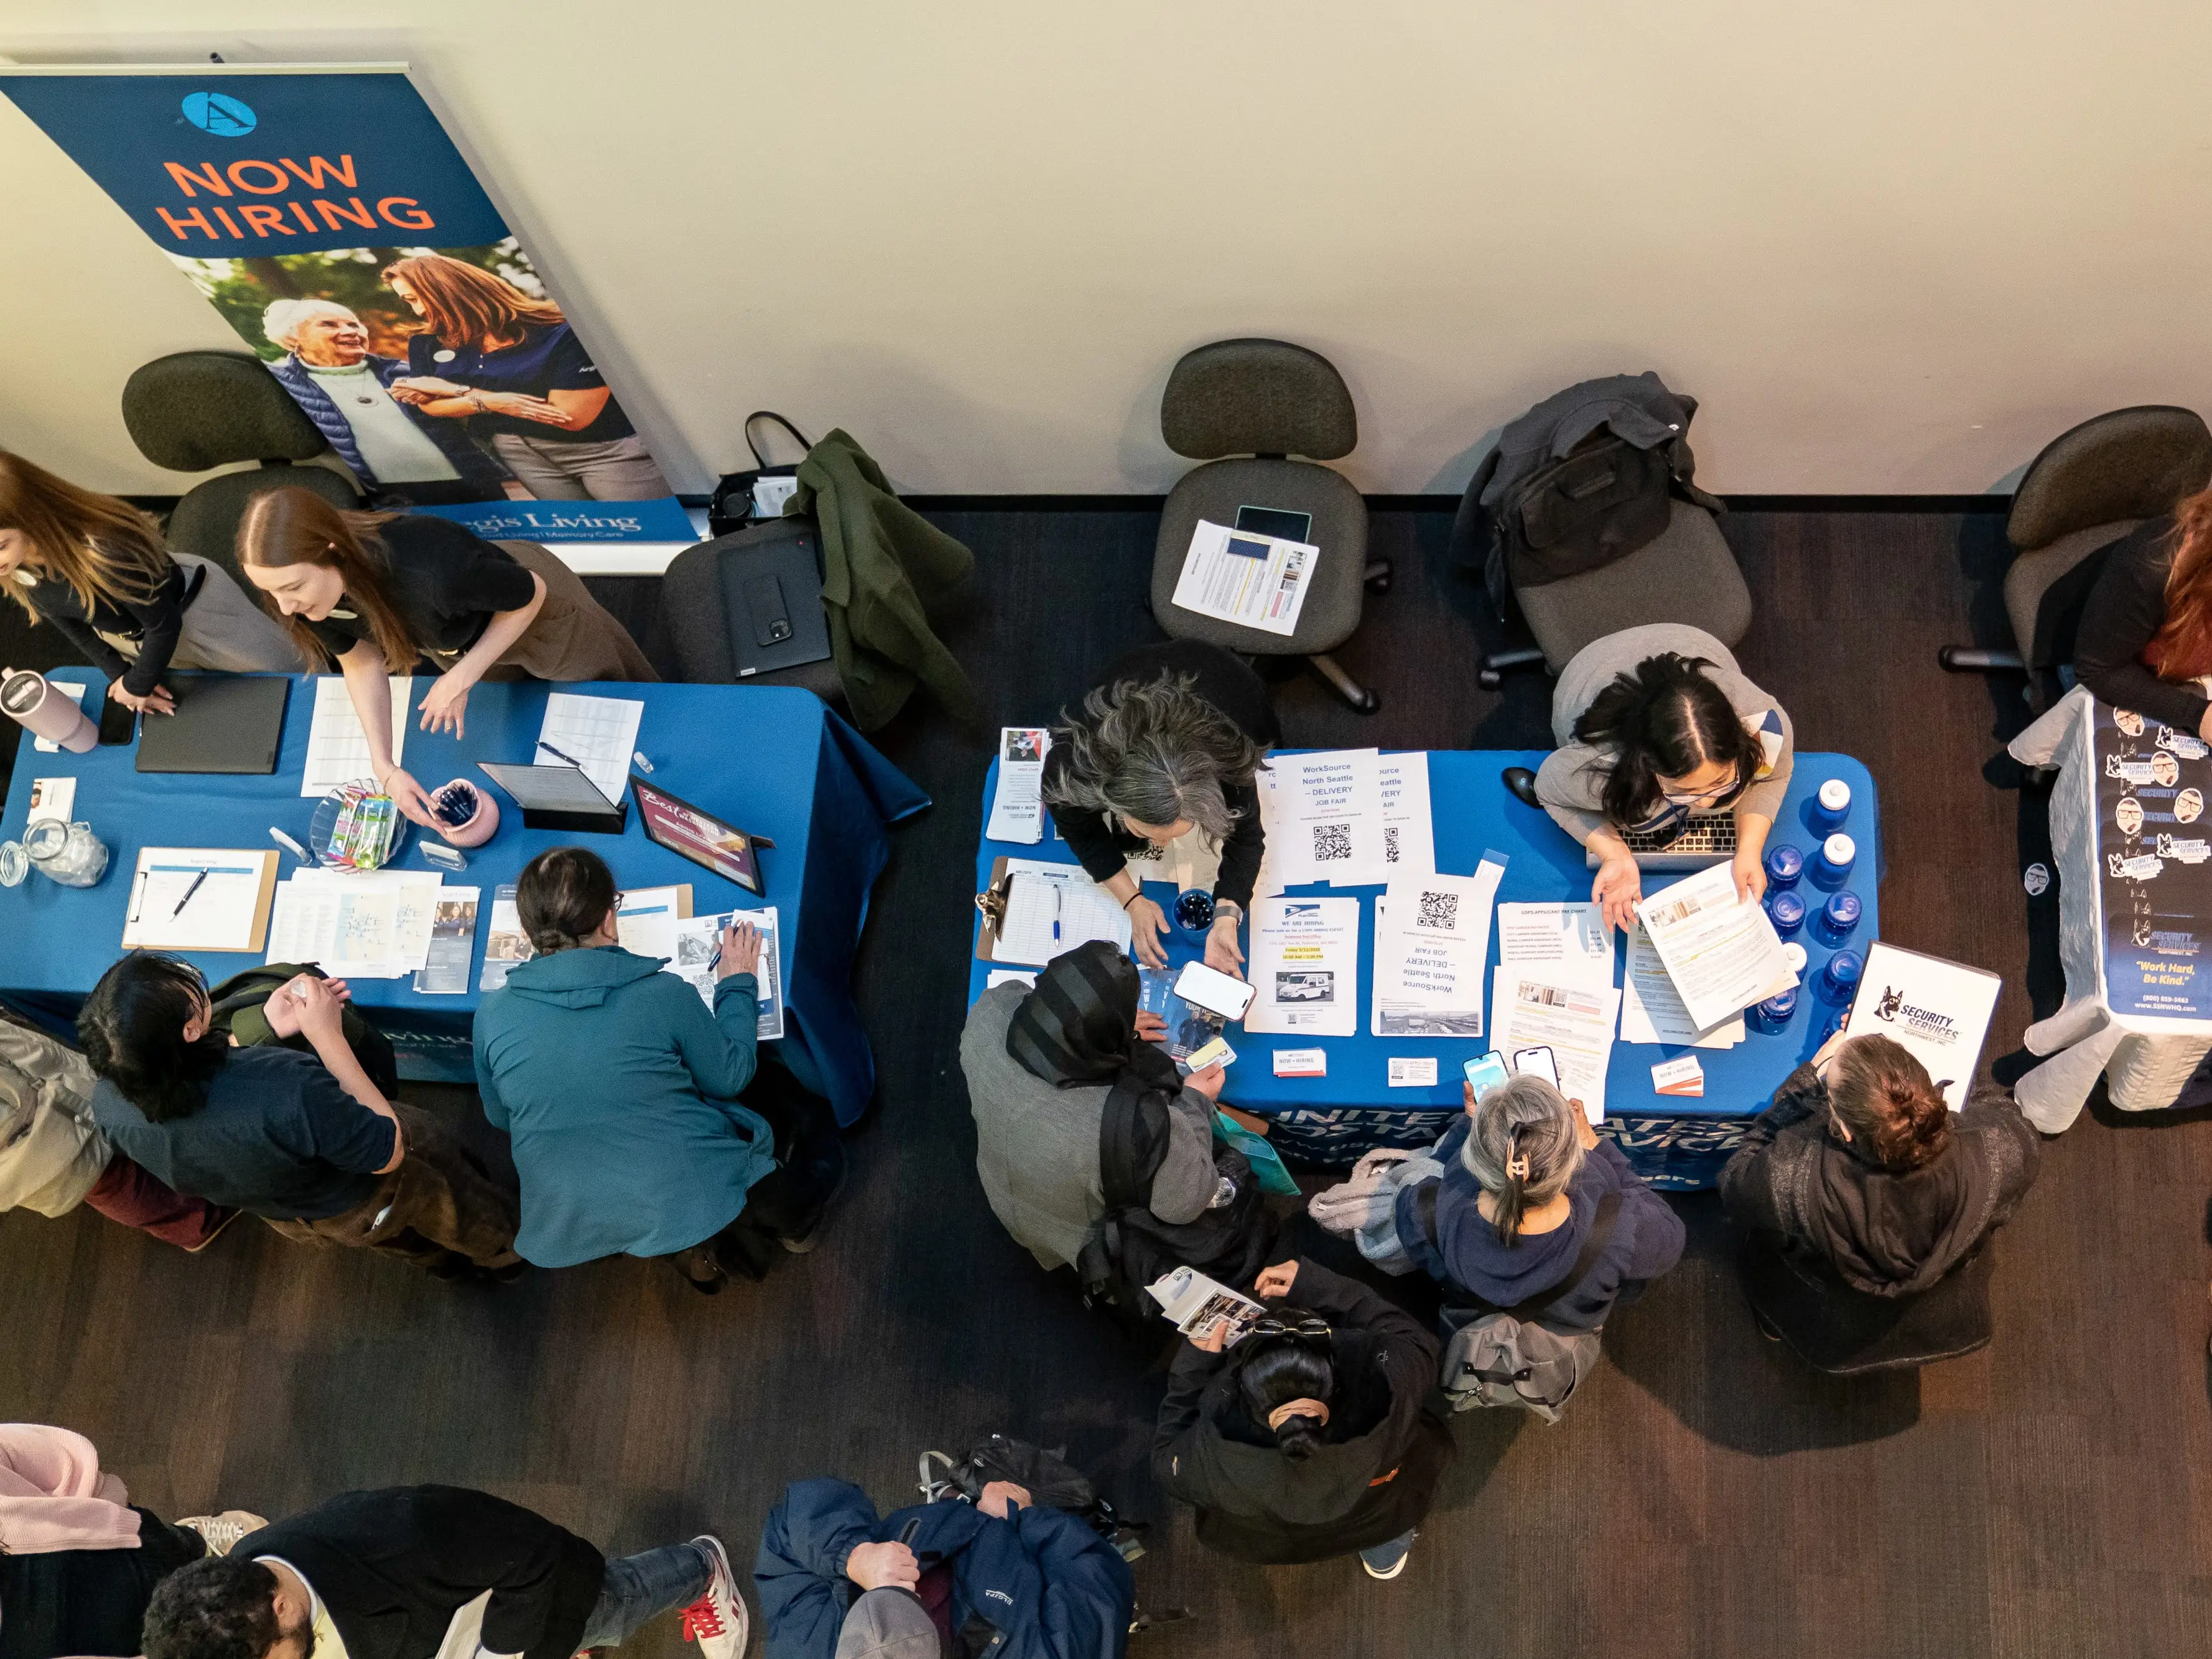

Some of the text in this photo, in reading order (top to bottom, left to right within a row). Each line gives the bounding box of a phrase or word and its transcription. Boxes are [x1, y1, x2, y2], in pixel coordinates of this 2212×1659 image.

[162, 154, 358, 197] NOW
[155, 197, 435, 240] HIRING
[462, 513, 641, 532] egis Living
[1303, 764, 1351, 773] WorkSource
[1303, 775, 1354, 785] North Seattle
[1313, 786, 1353, 796] DELIVERY
[2137, 788, 2179, 797] SECURITY
[643, 789, 679, 818] Best
[2124, 856, 2154, 867] SECURITY
[2132, 861, 2161, 870] SERVICES
[2150, 931, 2193, 941] SECURITY
[2158, 940, 2200, 950] SERVICES
[1406, 957, 1448, 969] DELIVERY
[2168, 963, 2195, 975] Hard,
[1403, 969, 1455, 981] North Seattle
[2144, 974, 2157, 983] Be
[1403, 981, 1452, 993] WorkSource
[1900, 1005, 1954, 1027] SECURITY
[1907, 1018, 1959, 1041] SERVICES
[1676, 1064, 1694, 1073] HIRING
[1275, 1109, 1465, 1125] NITE
[1276, 1122, 1438, 1139] OSTA
[1594, 1117, 1755, 1137] ATES
